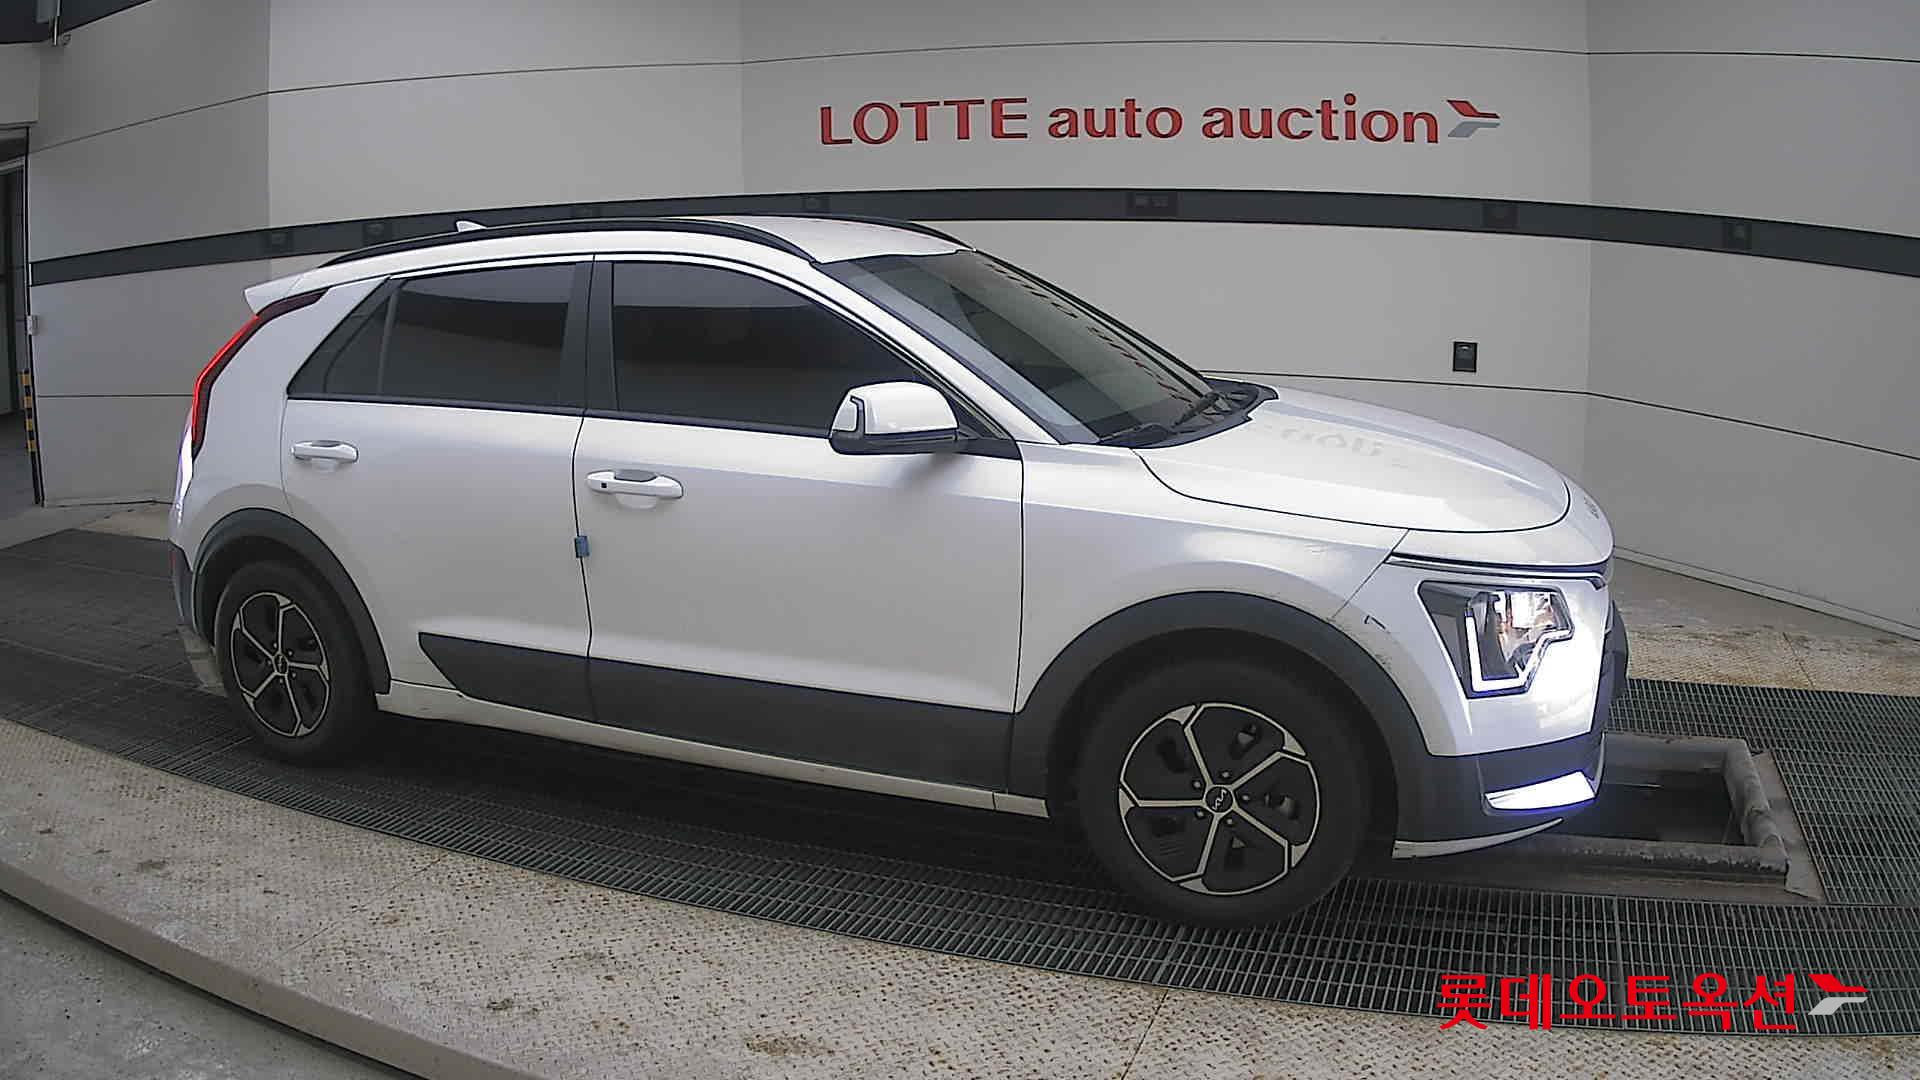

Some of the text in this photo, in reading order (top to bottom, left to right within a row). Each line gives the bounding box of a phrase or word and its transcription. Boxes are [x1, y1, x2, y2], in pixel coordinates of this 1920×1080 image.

[820, 93, 1440, 145] LOTTE auto auction
